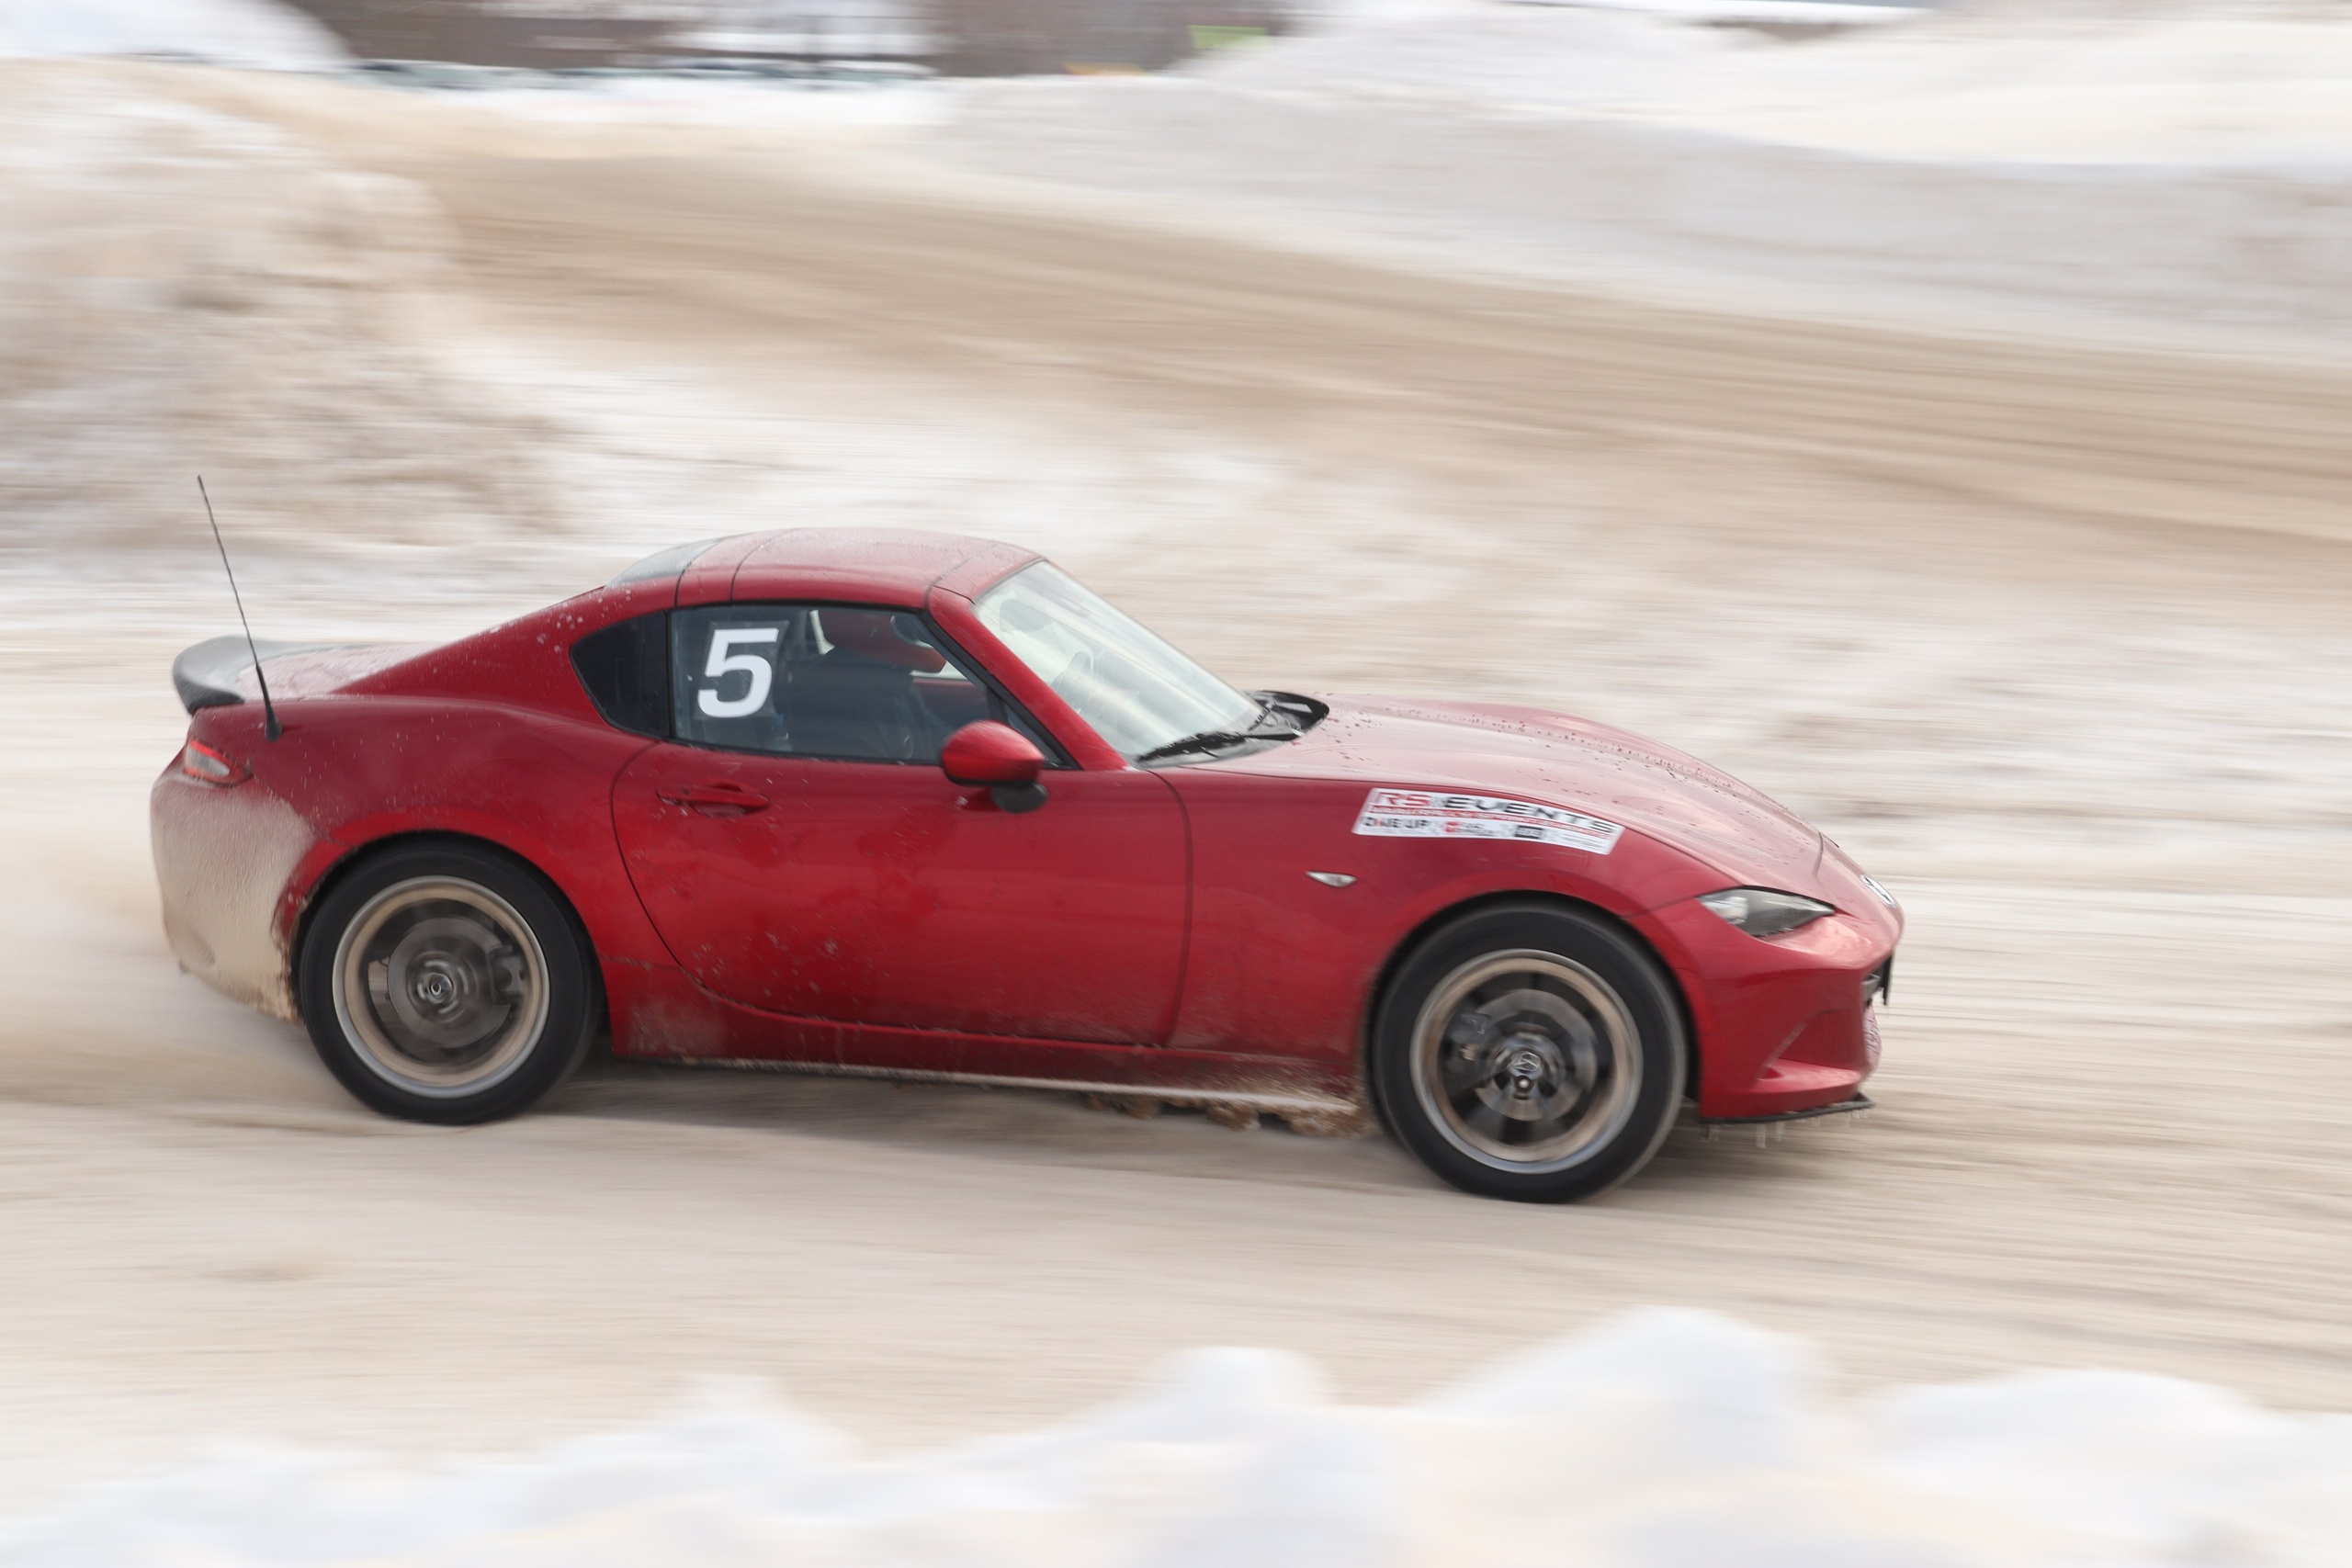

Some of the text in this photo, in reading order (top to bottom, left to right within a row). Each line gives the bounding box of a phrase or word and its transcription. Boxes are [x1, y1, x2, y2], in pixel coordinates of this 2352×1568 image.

[698, 628, 779, 718] 5
[1376, 791, 1431, 807] RS
[1443, 796, 1614, 834] EVENTS
